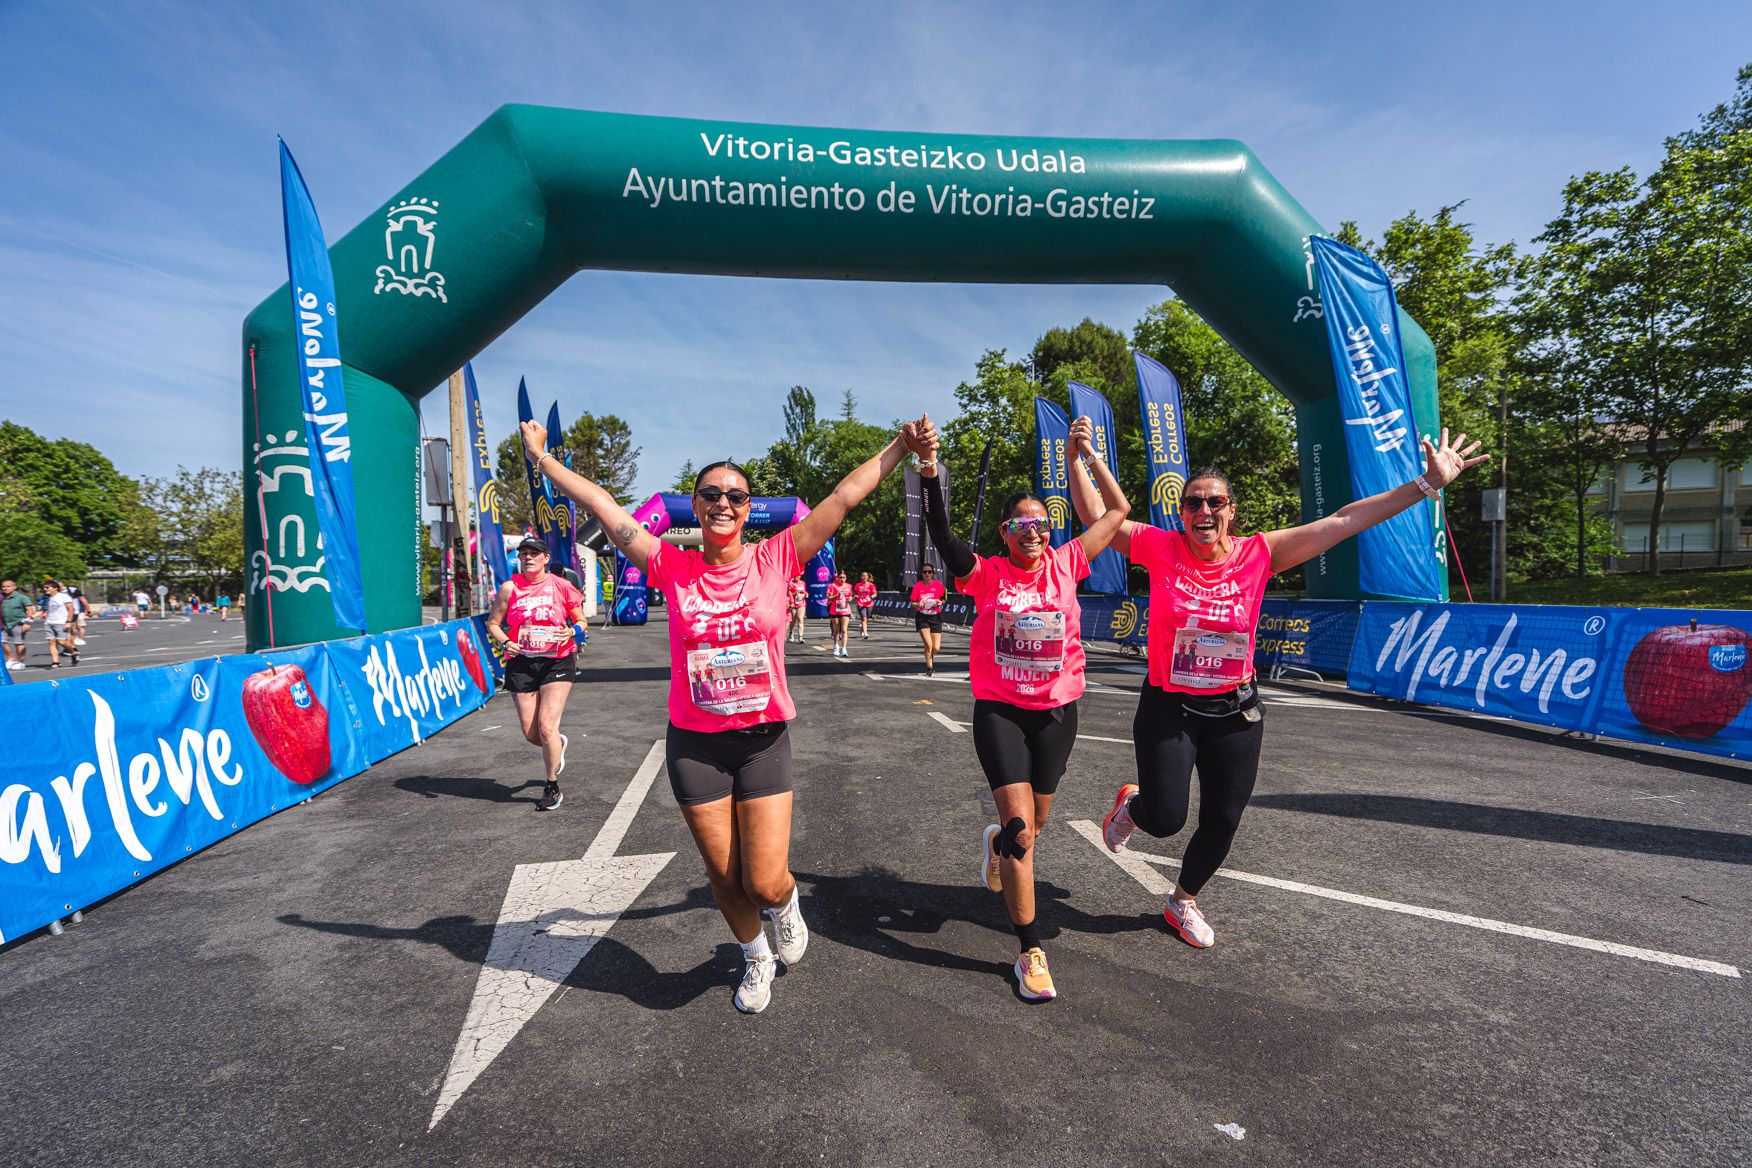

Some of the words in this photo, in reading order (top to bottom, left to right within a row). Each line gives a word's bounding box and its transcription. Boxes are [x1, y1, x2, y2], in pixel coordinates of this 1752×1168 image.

[700, 132, 986, 172] Vitoria-Gasteizko
[997, 148, 1086, 174] Udala
[622, 167, 865, 211] Ayuntamiento
[877, 181, 916, 214] de
[927, 184, 1155, 220] Vitoria-Gasteiz
[1207, 601, 1231, 622] DE
[717, 616, 742, 642] DE
[1258, 613, 1312, 633] Correos
[1015, 640, 1042, 650] 016
[1255, 634, 1306, 656] Express
[1196, 656, 1222, 667] 016
[1376, 610, 1597, 714] Marlene
[361, 634, 466, 744] Marlene
[716, 677, 746, 691] 016
[1016, 684, 1034, 693] 2026
[0, 688, 243, 873] arlene
